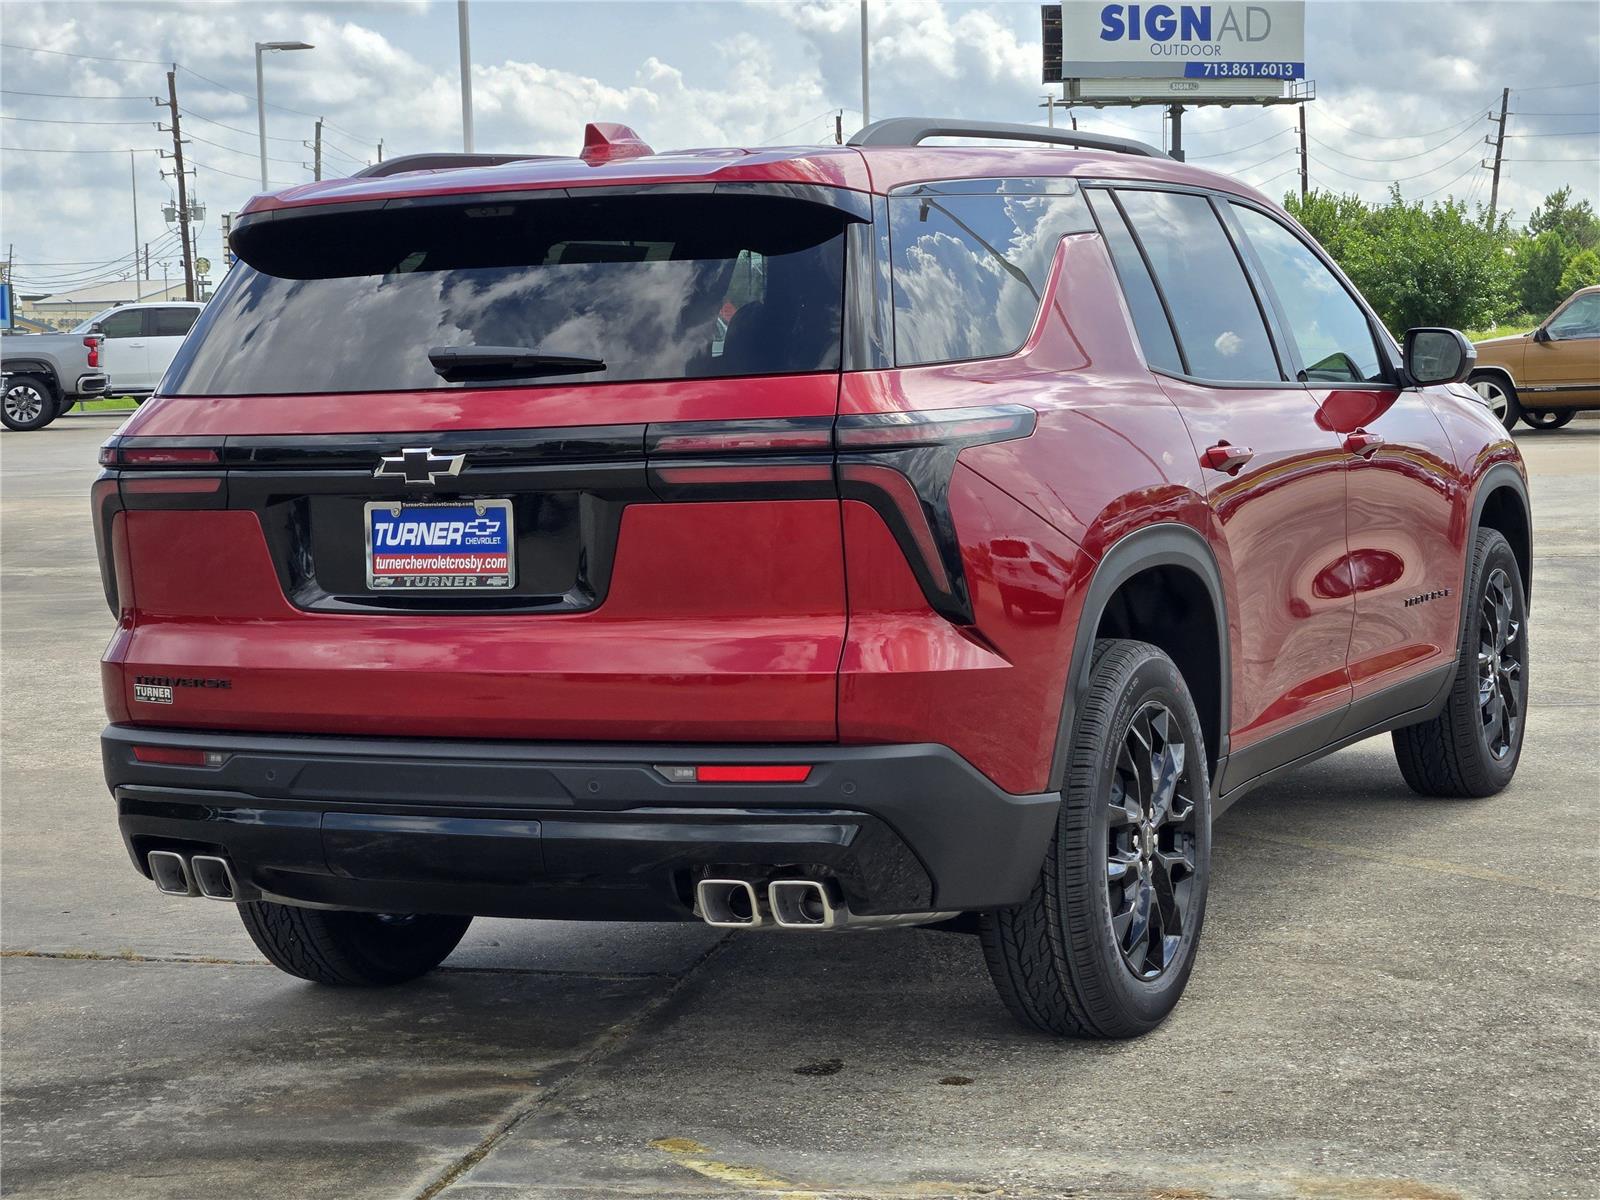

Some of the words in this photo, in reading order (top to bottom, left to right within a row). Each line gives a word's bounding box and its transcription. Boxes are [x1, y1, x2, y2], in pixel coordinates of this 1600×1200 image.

[1150, 43, 1222, 56] OUTDOOR
[1203, 63, 1293, 76] 713.861.6013
[374, 522, 464, 546] TURNER
[465, 536, 501, 545] CHEVROLET
[375, 555, 507, 572] turnerchevroletcrosby.com
[403, 576, 477, 587] TURNER
[136, 686, 171, 698] TURNER
